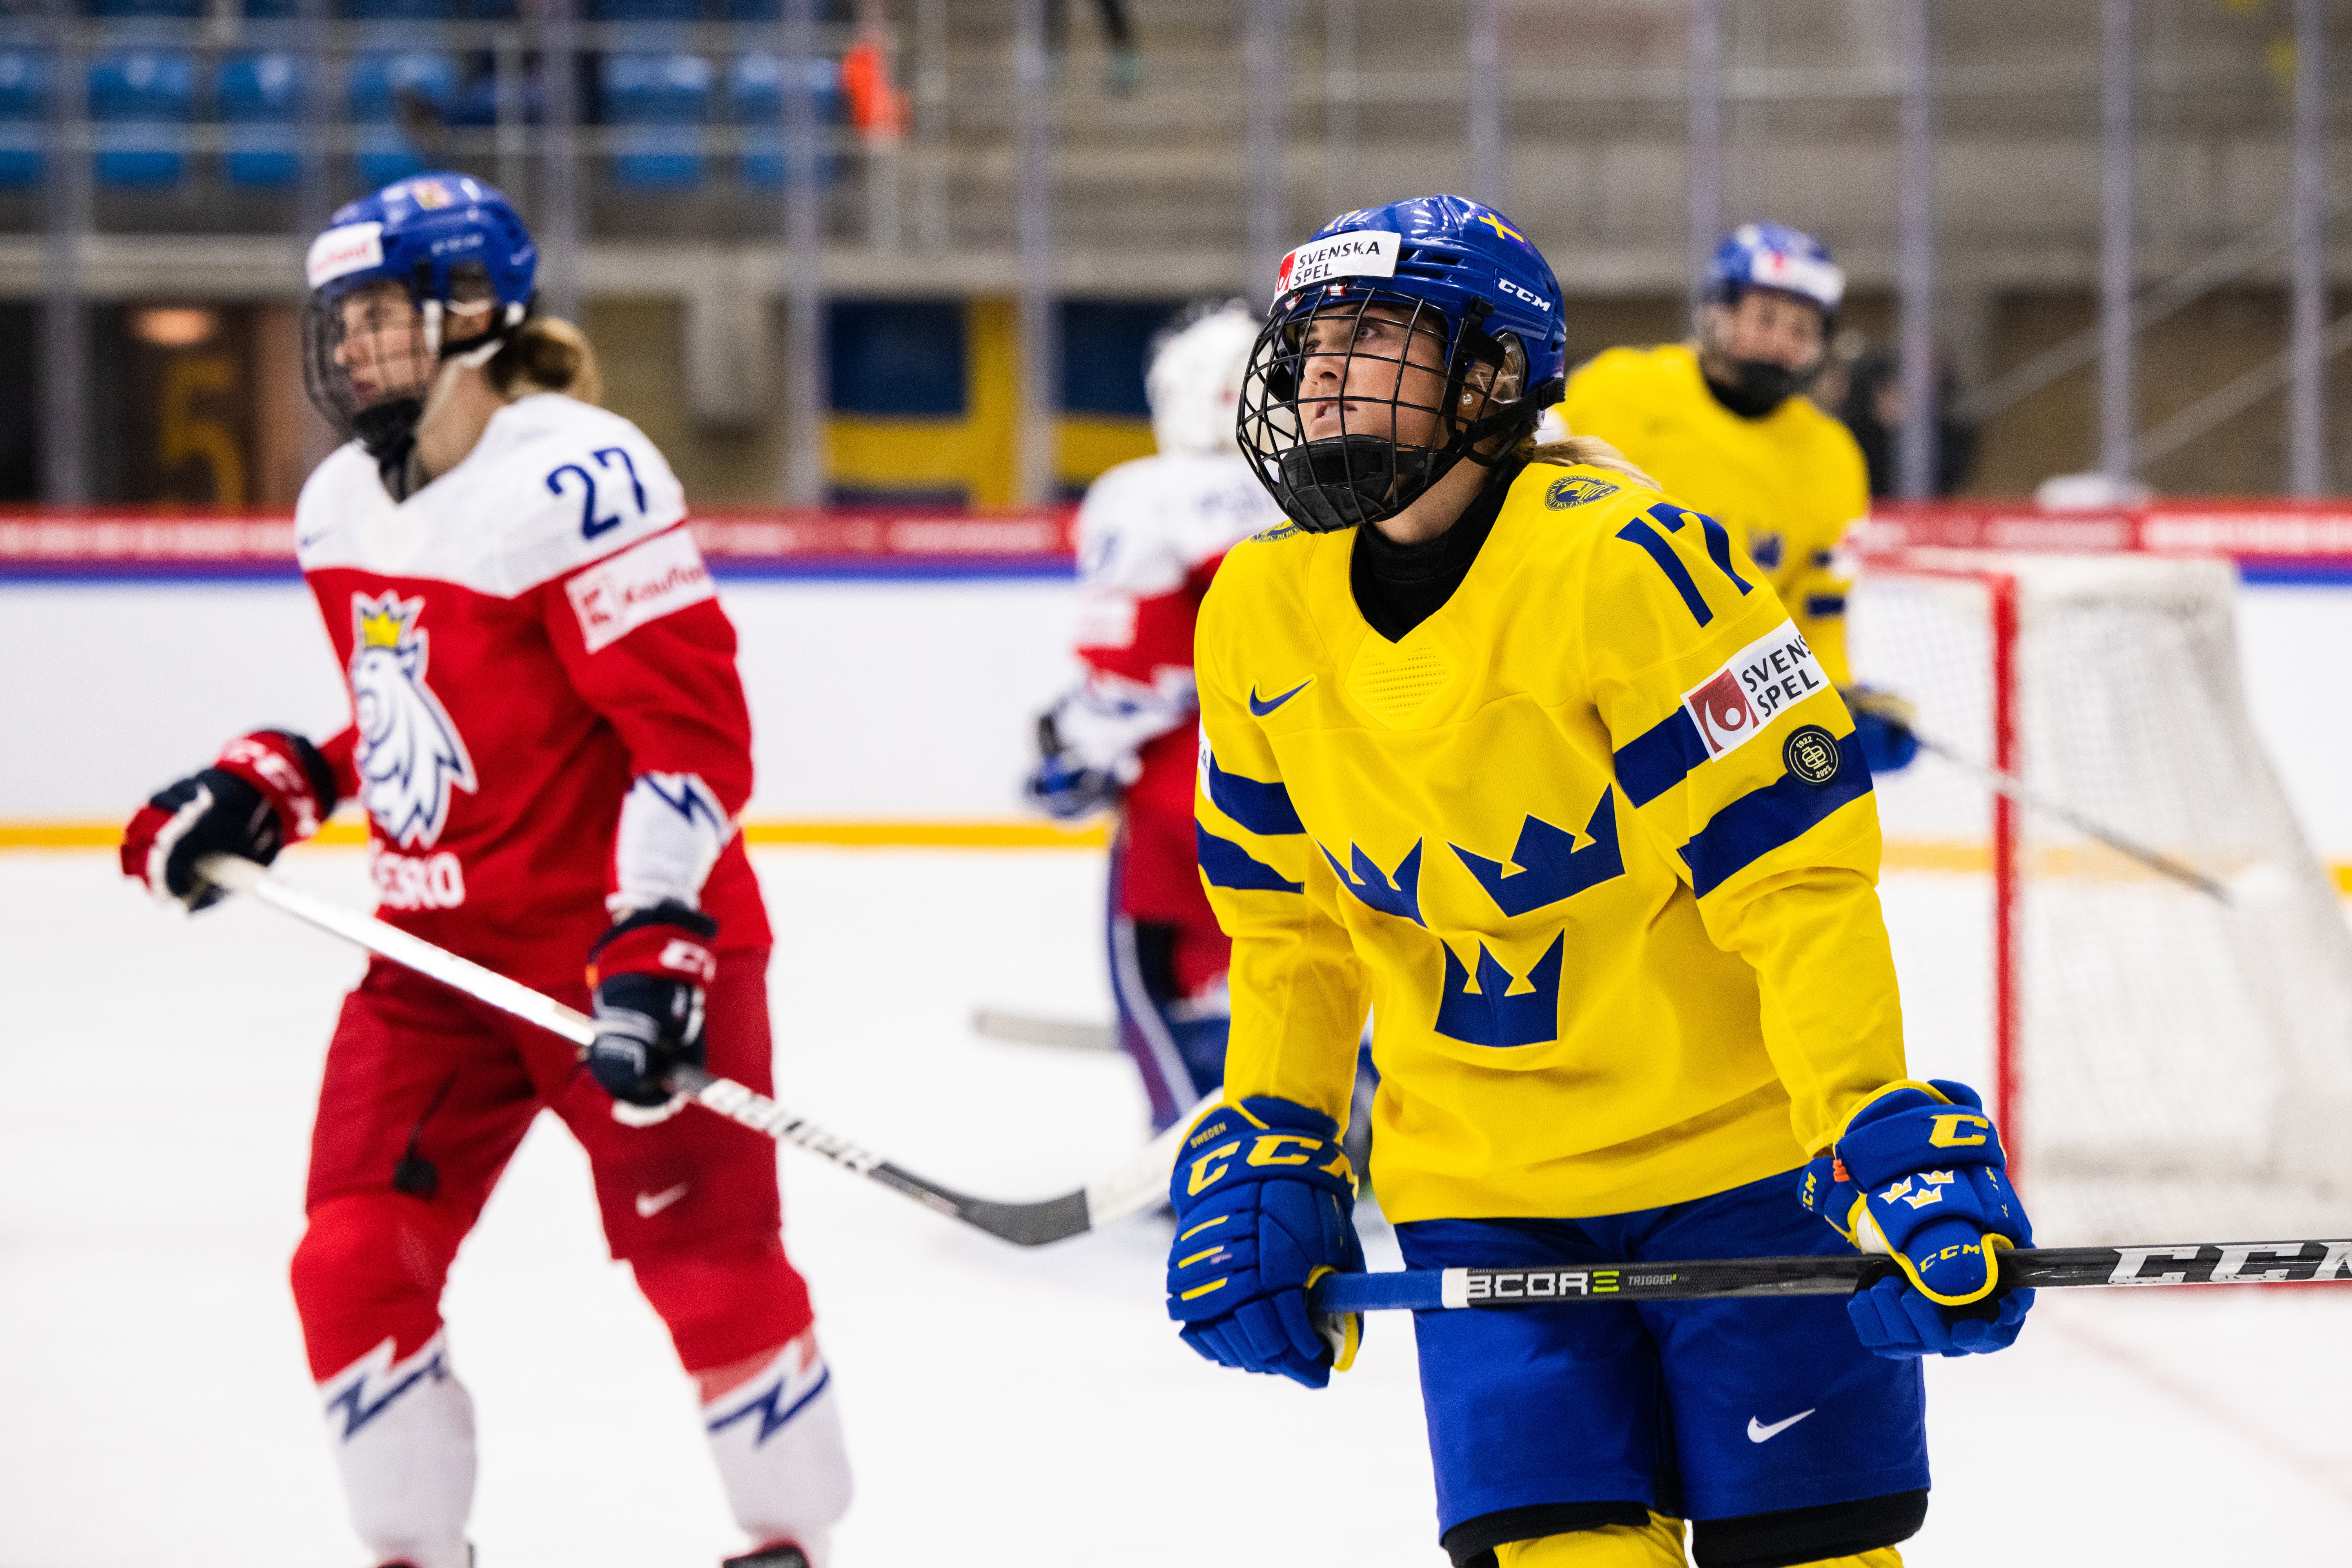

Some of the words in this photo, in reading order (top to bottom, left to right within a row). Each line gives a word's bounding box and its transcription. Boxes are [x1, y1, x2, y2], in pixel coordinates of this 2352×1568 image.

[1298, 241, 1380, 270] SVENSKA
[1294, 263, 1332, 287] SPEL
[1498, 278, 1551, 312] CCM
[545, 447, 647, 541] 27
[1615, 503, 1754, 628] 17
[1757, 669, 1820, 718] SPEL
[1796, 736, 1813, 749] 1922
[1816, 765, 1832, 779] 2022
[1190, 1122, 1227, 1148] SWEDEN
[1919, 1244, 1980, 1273] CCM
